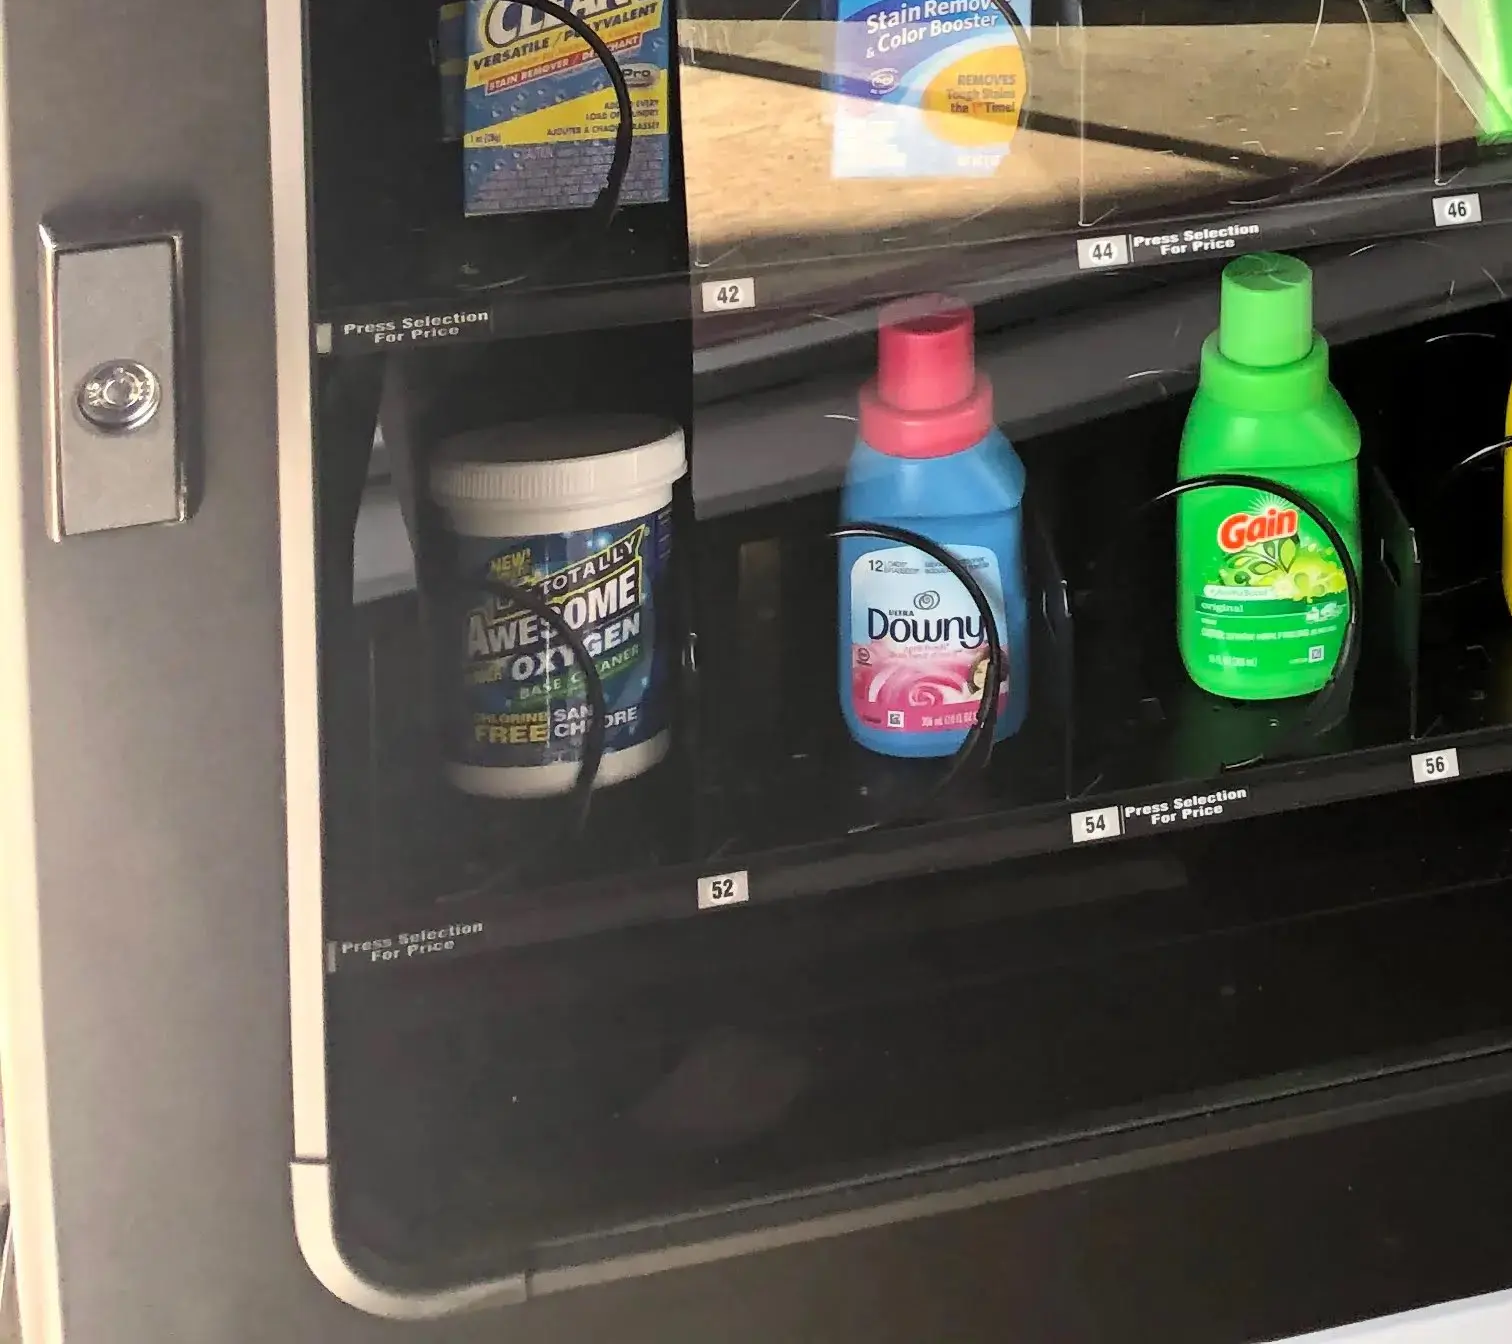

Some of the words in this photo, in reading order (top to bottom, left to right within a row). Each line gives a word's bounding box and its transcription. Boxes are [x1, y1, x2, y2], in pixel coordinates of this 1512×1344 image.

[866, 3, 920, 34] Stain
[866, 46, 875, 58] &
[878, 27, 926, 52] Color
[930, 14, 998, 36] Booster
[473, 37, 550, 70] VERSATILE
[488, 73, 517, 91] STAIN
[521, 58, 569, 79] REMOVER
[622, 67, 651, 78] Pro
[958, 74, 1016, 86] REMOVES
[947, 88, 979, 102] Tough
[951, 102, 969, 113] the
[986, 102, 1015, 113] Time!
[1447, 201, 1467, 218] 46
[1133, 233, 1179, 248] Press
[1183, 224, 1259, 241] Selection
[1092, 243, 1114, 261] 44
[1160, 242, 1195, 256] For
[1199, 238, 1235, 252] Price
[717, 286, 739, 304] 42
[344, 319, 396, 336] Press
[401, 310, 488, 329] Selection
[374, 329, 411, 344] For
[415, 325, 460, 340] Price
[1219, 508, 1297, 550] Gain
[491, 548, 531, 573] NEW!
[543, 536, 635, 594] TOTALLY
[868, 560, 883, 573] 12
[889, 609, 915, 617] ULTRA
[1201, 602, 1244, 613] original
[868, 608, 987, 649] Downy
[520, 678, 561, 699] BASE
[475, 725, 547, 744] FREE
[1426, 756, 1445, 774] 56
[1125, 801, 1169, 817] Press
[1174, 788, 1247, 808] Selection
[1085, 815, 1105, 832] 54
[1151, 811, 1178, 825] For
[1181, 803, 1223, 820] Price
[711, 879, 733, 900] 52
[342, 937, 392, 954] Press
[398, 921, 483, 945] Selection
[371, 948, 401, 963] For
[406, 938, 455, 957] Price
